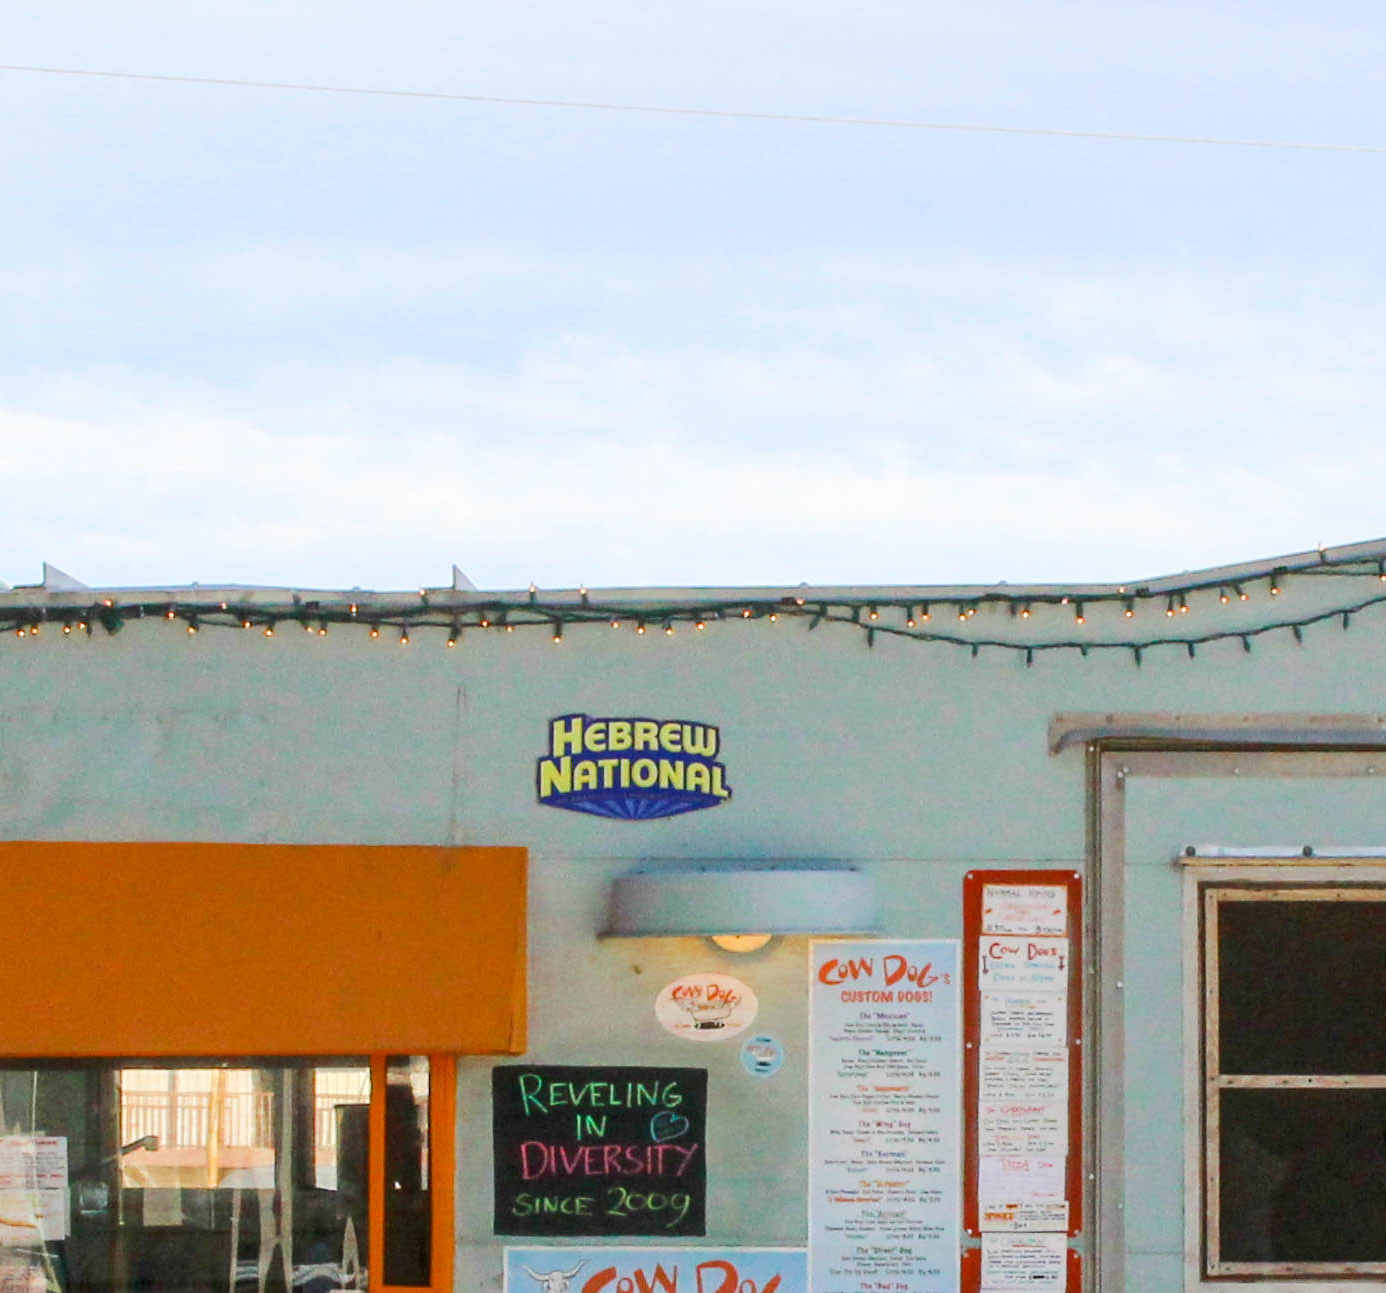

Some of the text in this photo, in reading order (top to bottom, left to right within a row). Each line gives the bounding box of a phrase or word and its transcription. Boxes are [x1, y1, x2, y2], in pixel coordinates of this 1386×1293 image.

[553, 717, 717, 757] HEBREW
[540, 756, 730, 798] NATIONAL
[841, 991, 894, 1003] CUSTOM
[519, 1074, 683, 1115] REVELING
[577, 1114, 607, 1140] IN
[521, 1140, 698, 1180] DIVERSITY
[513, 1186, 691, 1228] SINCE 2009
